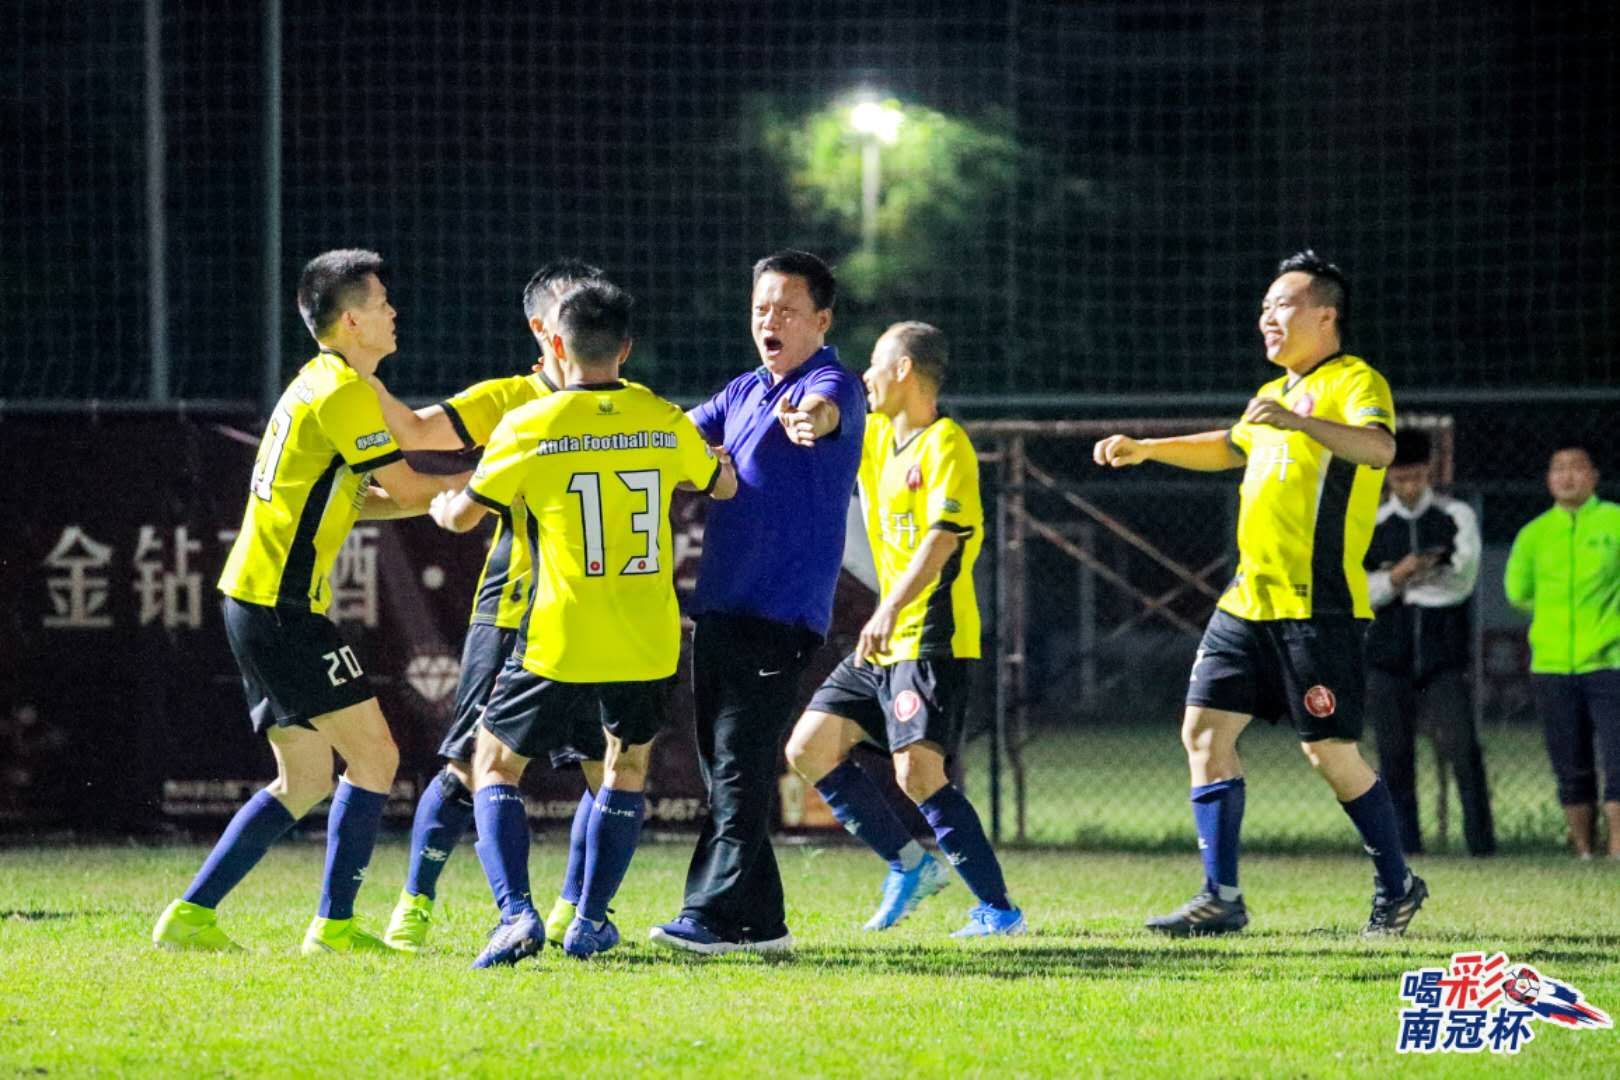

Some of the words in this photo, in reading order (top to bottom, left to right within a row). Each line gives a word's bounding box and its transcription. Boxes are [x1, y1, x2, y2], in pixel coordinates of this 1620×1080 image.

[537, 437, 580, 456] Anda
[583, 430, 649, 450] Football
[652, 430, 677, 448] Club
[567, 469, 660, 576] 13
[322, 645, 364, 687] 20
